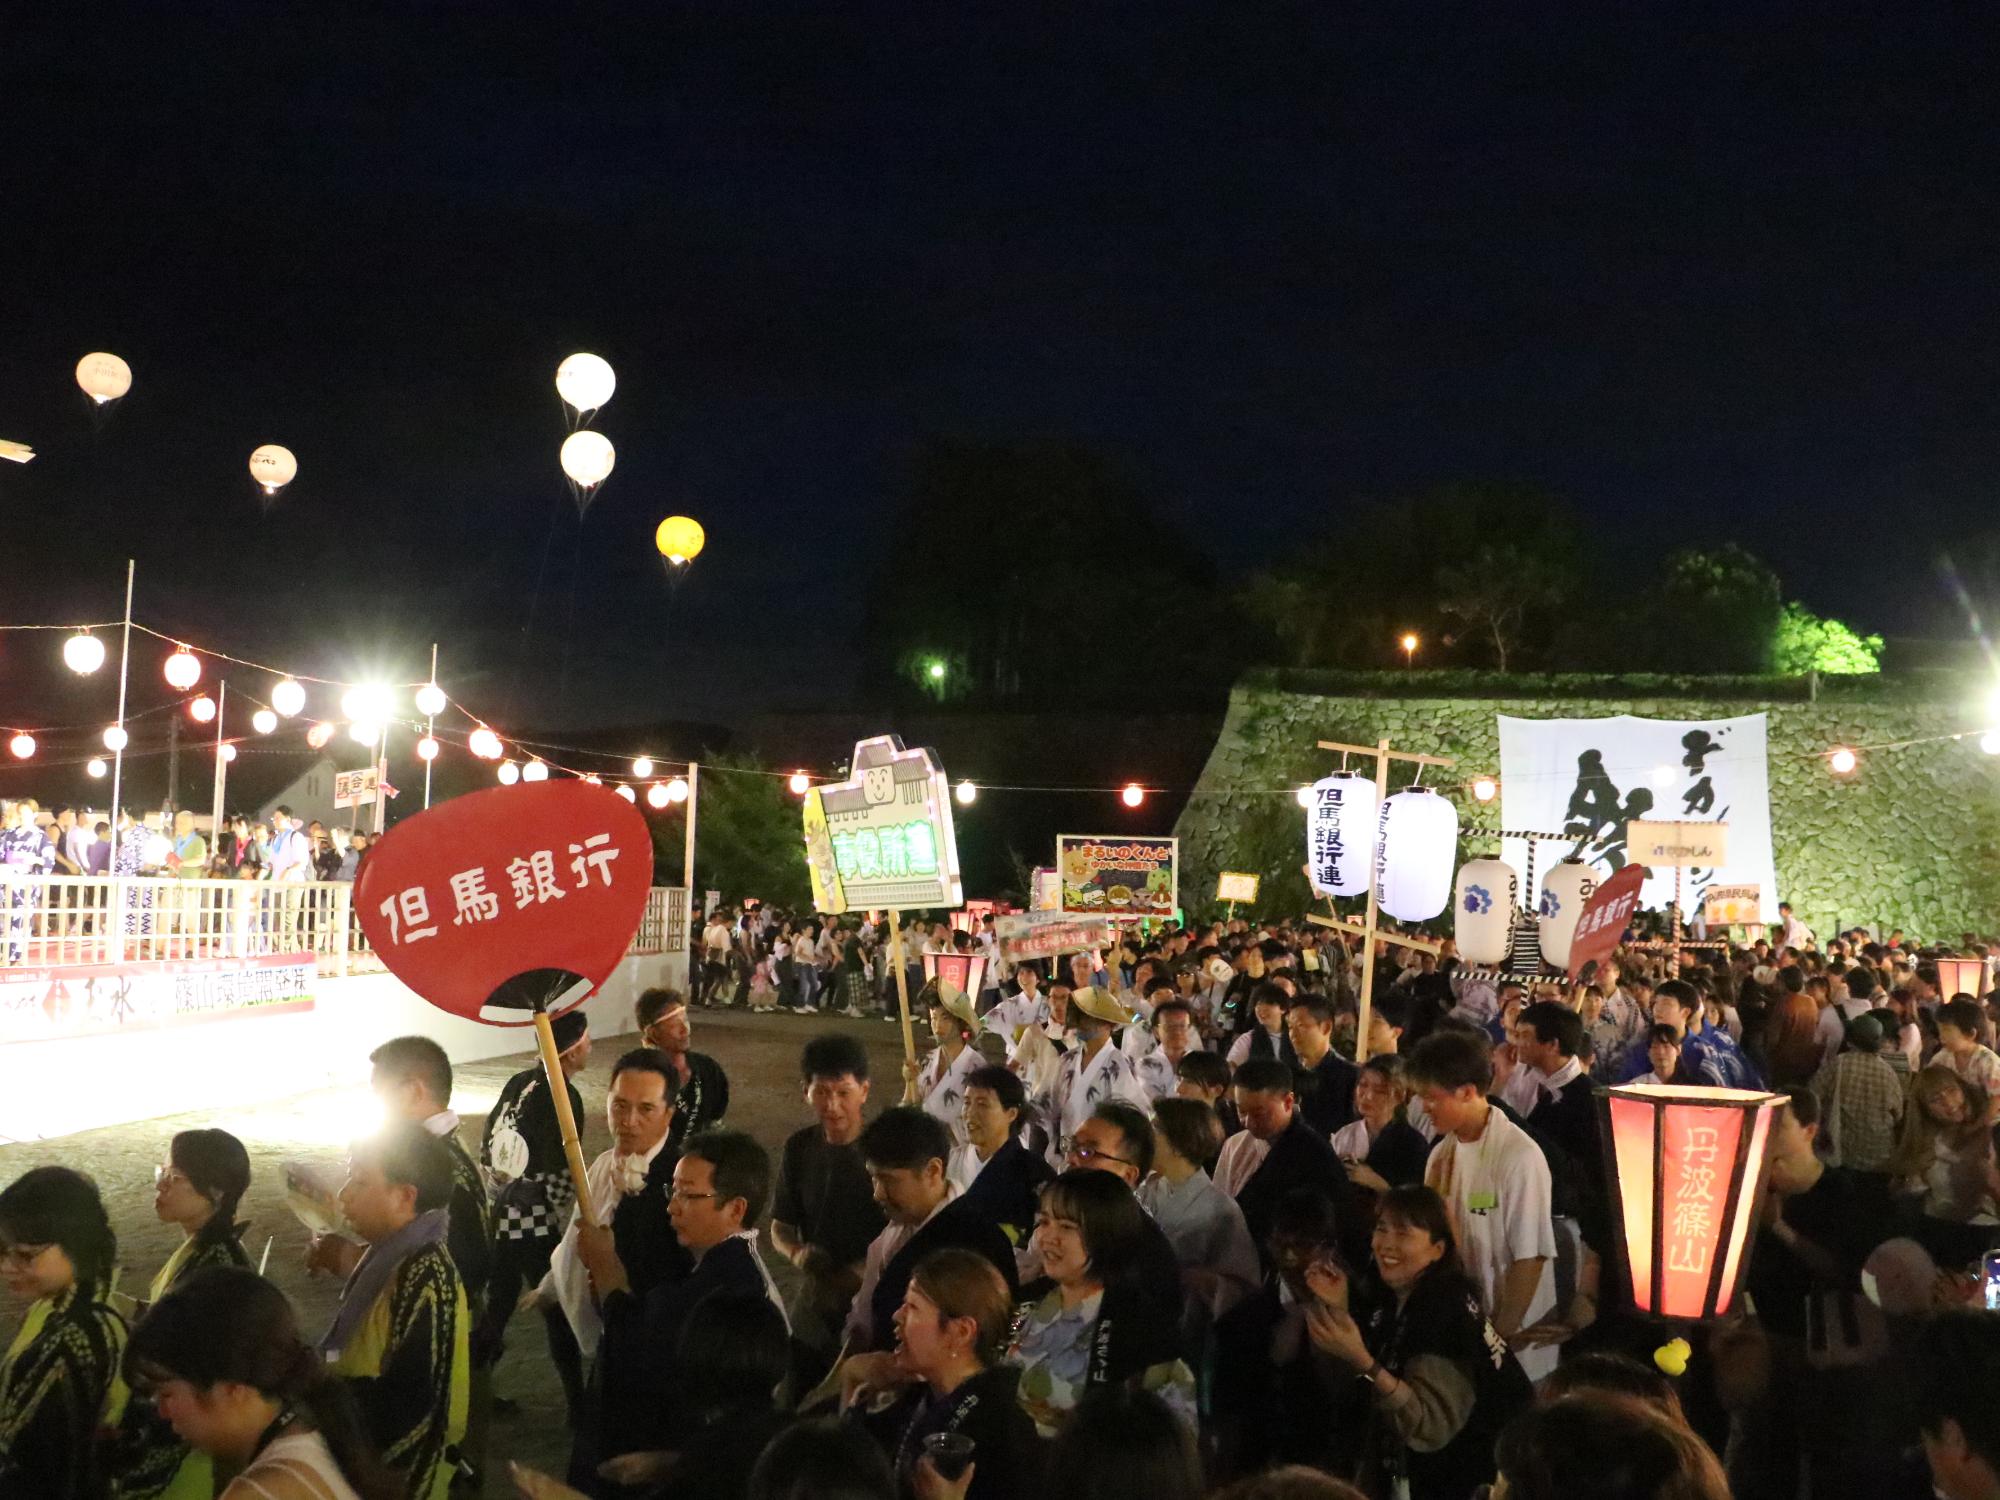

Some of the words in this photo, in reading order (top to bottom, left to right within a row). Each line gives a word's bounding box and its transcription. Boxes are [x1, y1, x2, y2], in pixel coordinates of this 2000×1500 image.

[380, 833, 619, 945] 但馬銀行
[1082, 845, 1168, 860] まるいのくんと
[1315, 789, 1344, 886] 但馬銀行連
[1669, 1127, 1719, 1274] 丹波篠山
